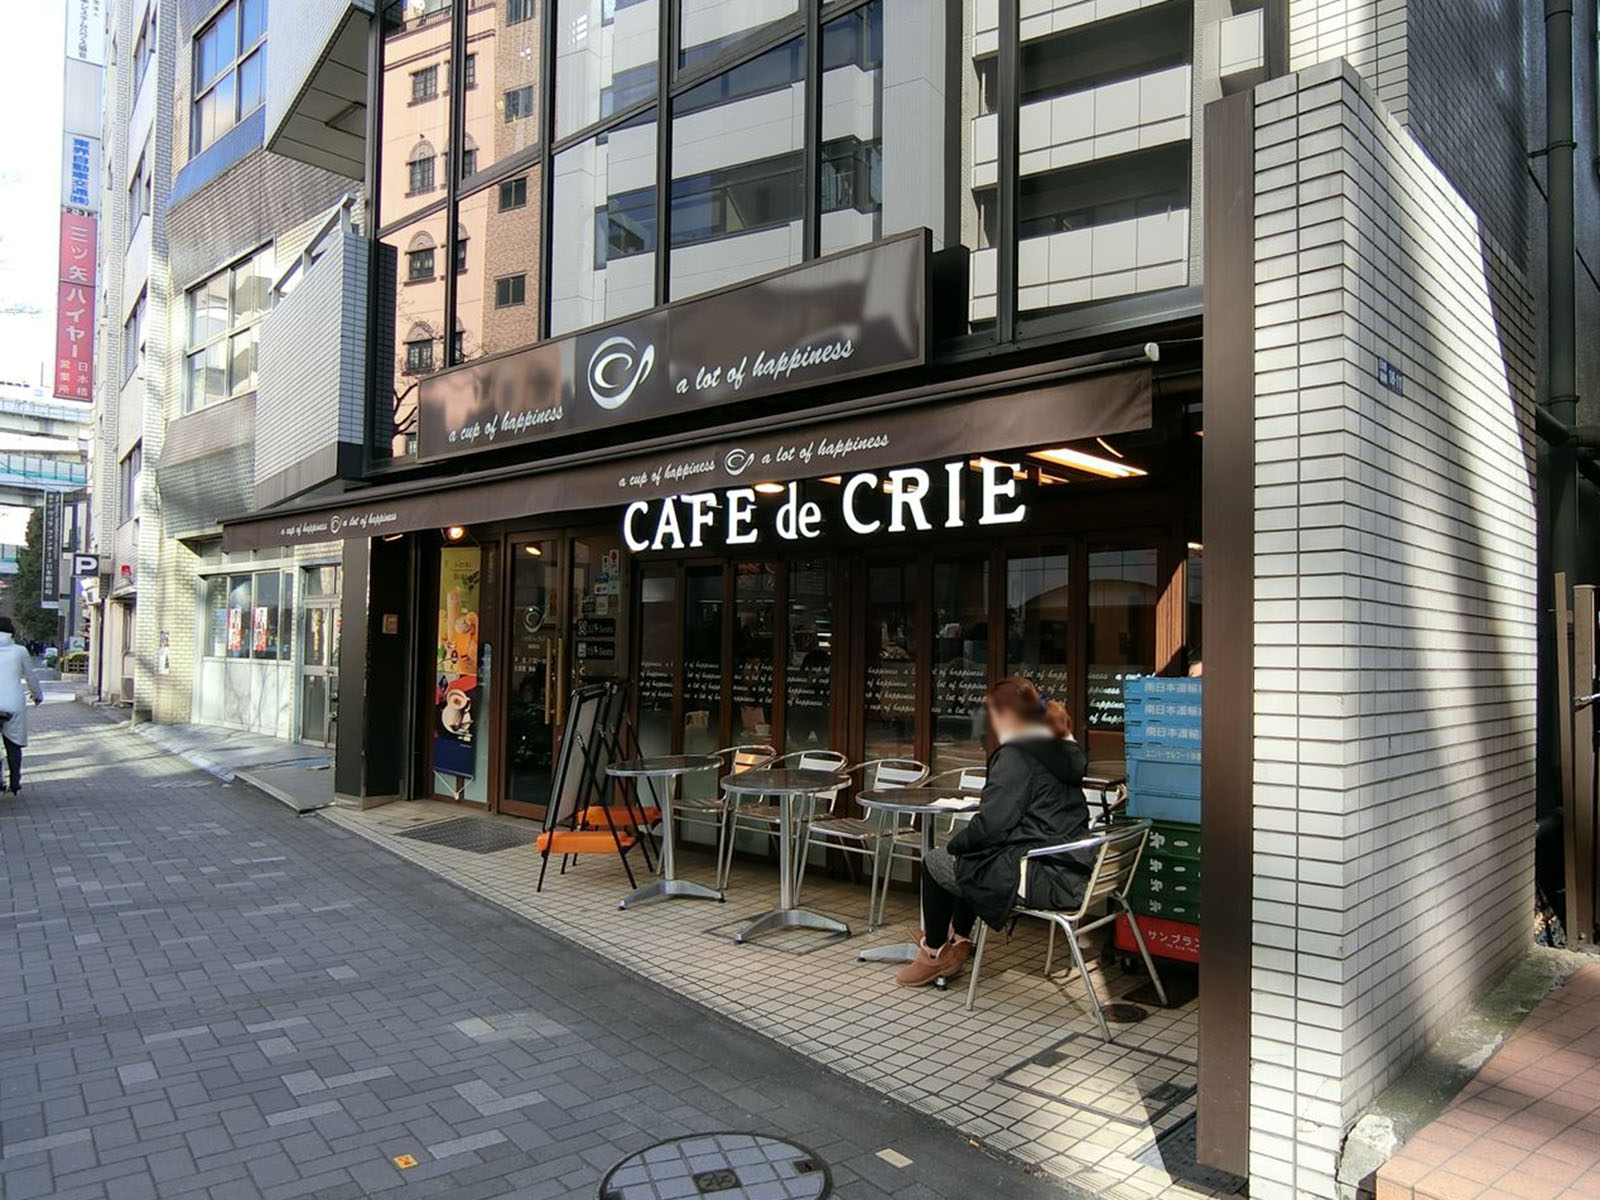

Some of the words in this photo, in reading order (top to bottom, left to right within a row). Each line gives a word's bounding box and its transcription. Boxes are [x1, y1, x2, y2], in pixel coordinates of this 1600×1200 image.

[66, 226, 88, 358] 三ツ矢ハイヤー
[676, 378, 689, 394] a
[696, 366, 722, 390] lot
[727, 356, 747, 390] of
[752, 339, 855, 383] happiness
[449, 430, 457, 442] a
[461, 422, 481, 443] cup
[485, 414, 498, 440] of
[501, 405, 563, 434] happiness
[619, 477, 626, 487] a
[629, 473, 648, 487] cup
[651, 466, 662, 486] of
[664, 460, 716, 481] happiness
[761, 454, 771, 464] a
[776, 446, 795, 463] lot
[799, 442, 814, 463] of
[818, 434, 889, 457] happiness
[342, 519, 347, 527] a
[349, 516, 359, 526] lot
[360, 513, 368, 528] of
[368, 513, 397, 527] happiness
[776, 482, 821, 539] de
[75, 556, 98, 575] P
[1144, 682, 1201, 694] 南日本運輸
[1145, 704, 1201, 717] 南日本運輸
